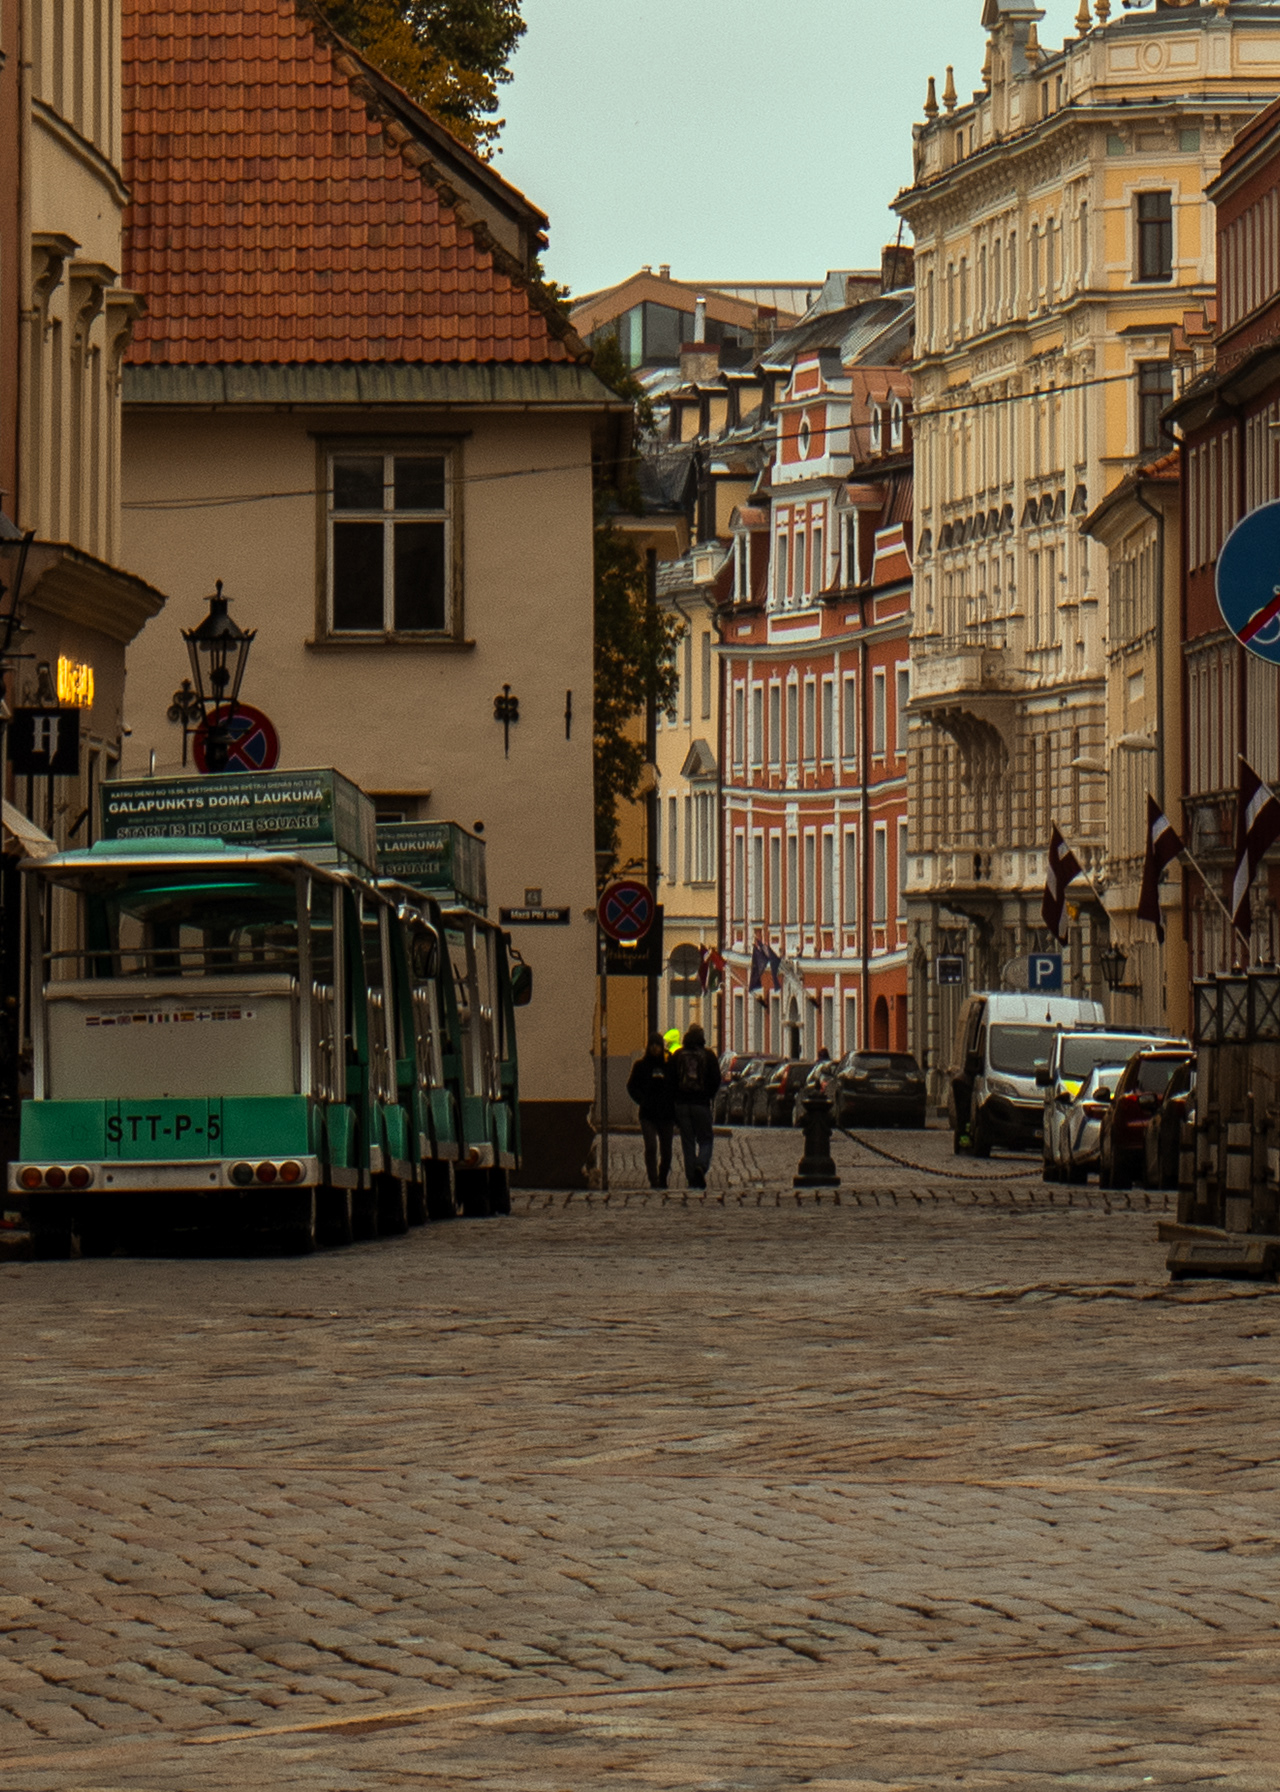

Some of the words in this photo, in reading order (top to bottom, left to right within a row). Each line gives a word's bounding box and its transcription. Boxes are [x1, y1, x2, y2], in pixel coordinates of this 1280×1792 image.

[108, 796, 205, 814] GALAPUNKTS
[208, 793, 250, 808] DOMA
[254, 788, 324, 804] LAUKUMĀ
[117, 824, 166, 839] START
[169, 823, 186, 837] IS
[189, 821, 206, 835] IN
[209, 818, 254, 834] DOME
[256, 815, 319, 832] SQUARE
[384, 839, 444, 852] LAUKUMĀ
[385, 861, 440, 875] SQUARE
[1035, 959, 1054, 985] P
[107, 1114, 221, 1142] STT-P-5
